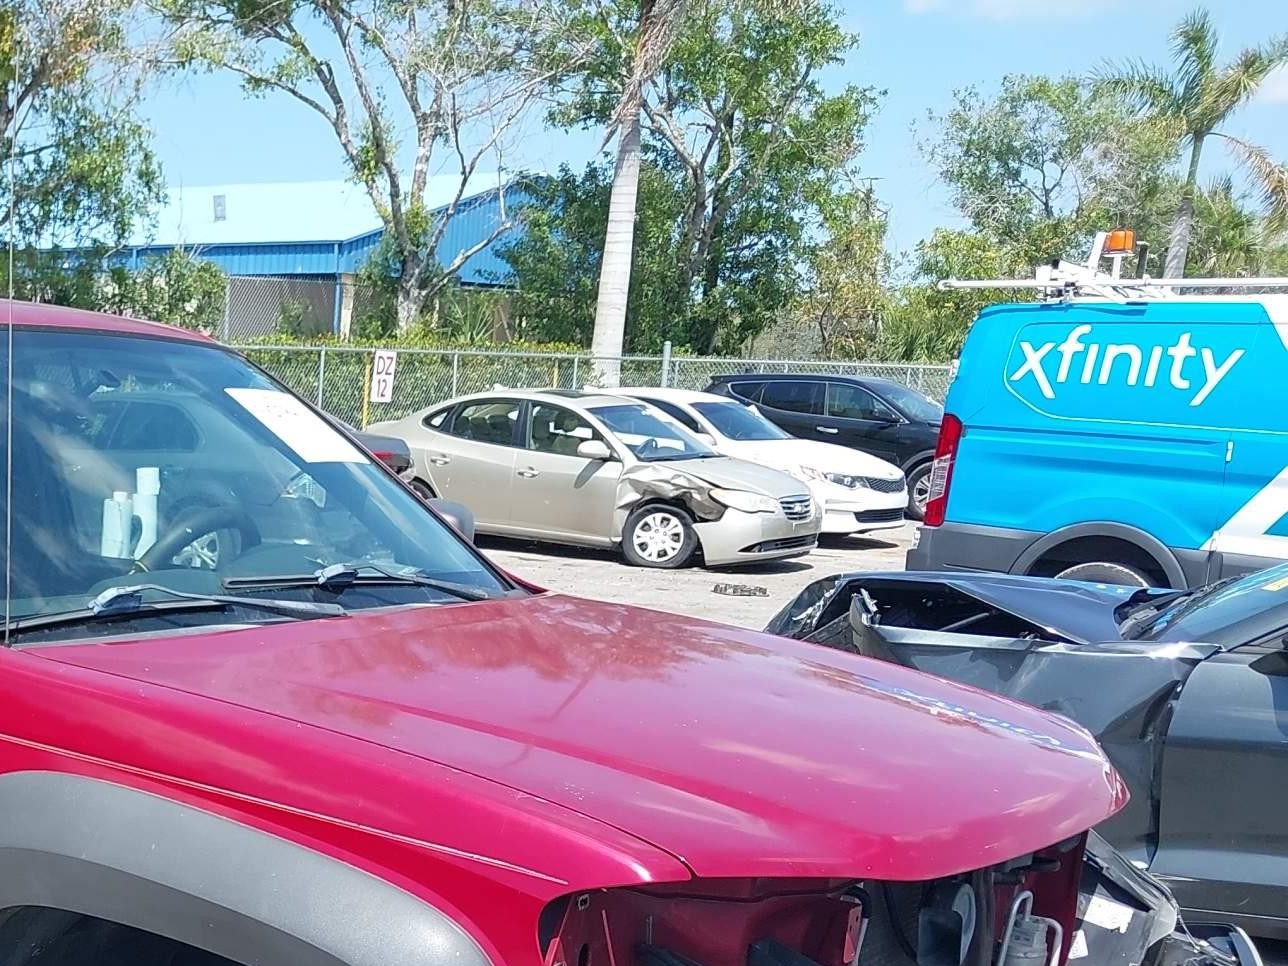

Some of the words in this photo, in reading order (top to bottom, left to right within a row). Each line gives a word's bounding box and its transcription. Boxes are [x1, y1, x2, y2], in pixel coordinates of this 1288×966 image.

[376, 355, 394, 375] DZ
[1009, 323, 1247, 407] xfinity
[376, 378, 388, 398] 12
